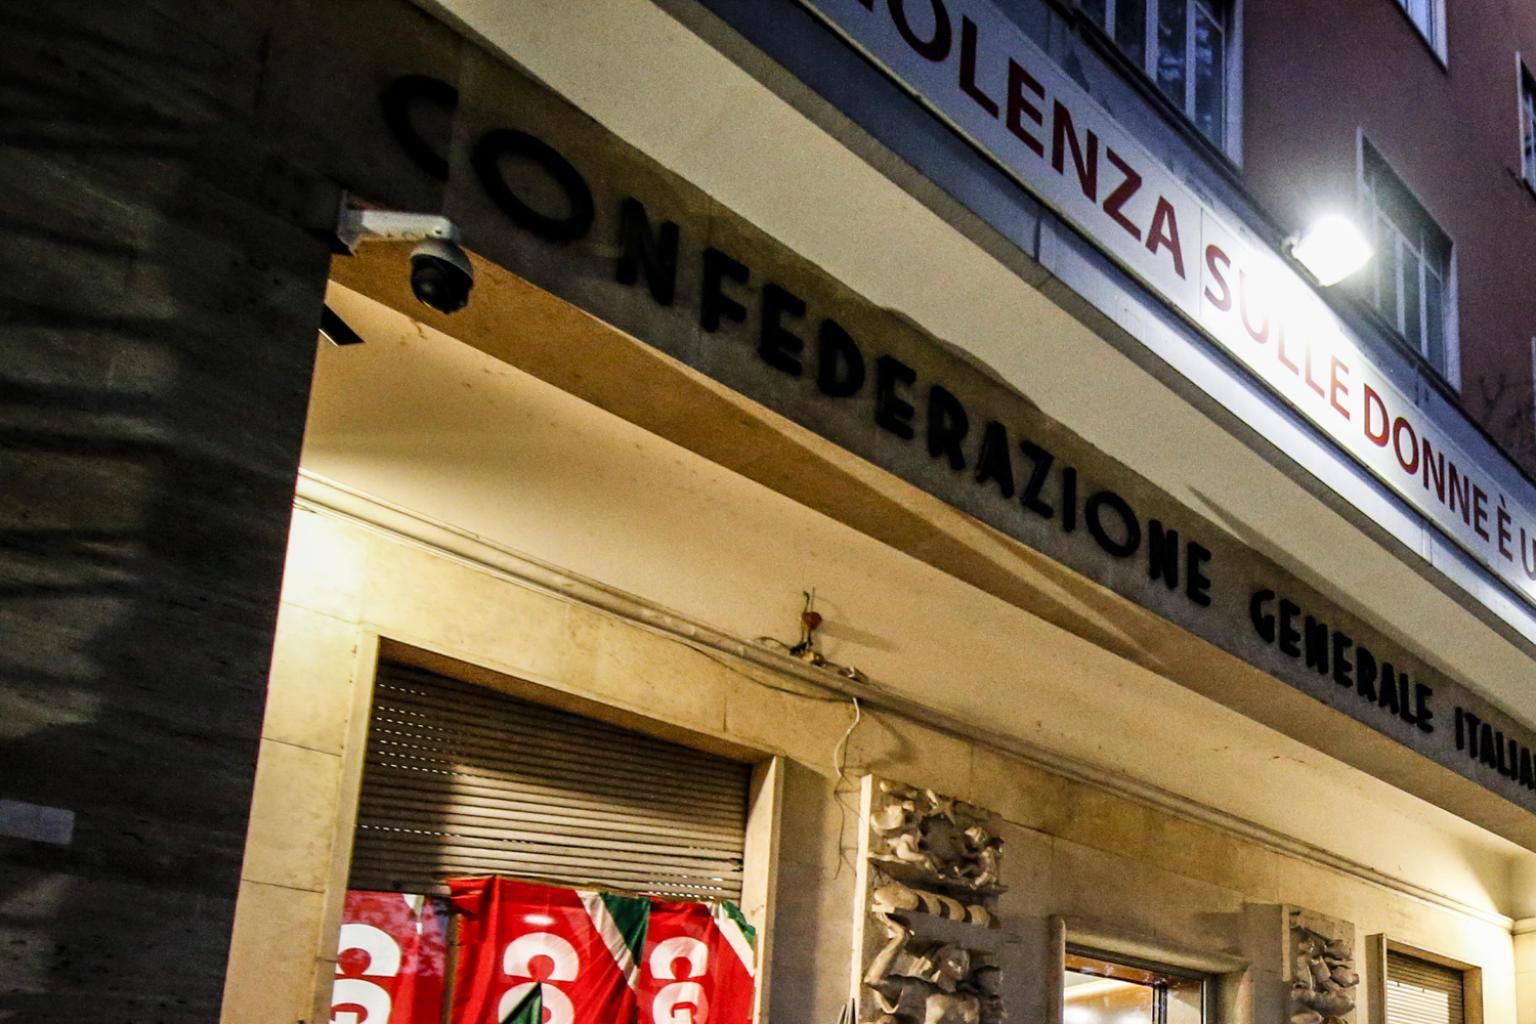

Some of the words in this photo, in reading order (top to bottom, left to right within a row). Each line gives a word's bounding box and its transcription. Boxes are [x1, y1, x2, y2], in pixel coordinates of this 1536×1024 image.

[380, 73, 1212, 608] CONFEDERAZIONE
[1249, 588, 1434, 734] GENERALE
[857, 0, 1187, 281] OLENZA
[1203, 242, 1352, 422] SULLE
[1363, 382, 1490, 542] DONNE
[1497, 492, 1514, 562] È
